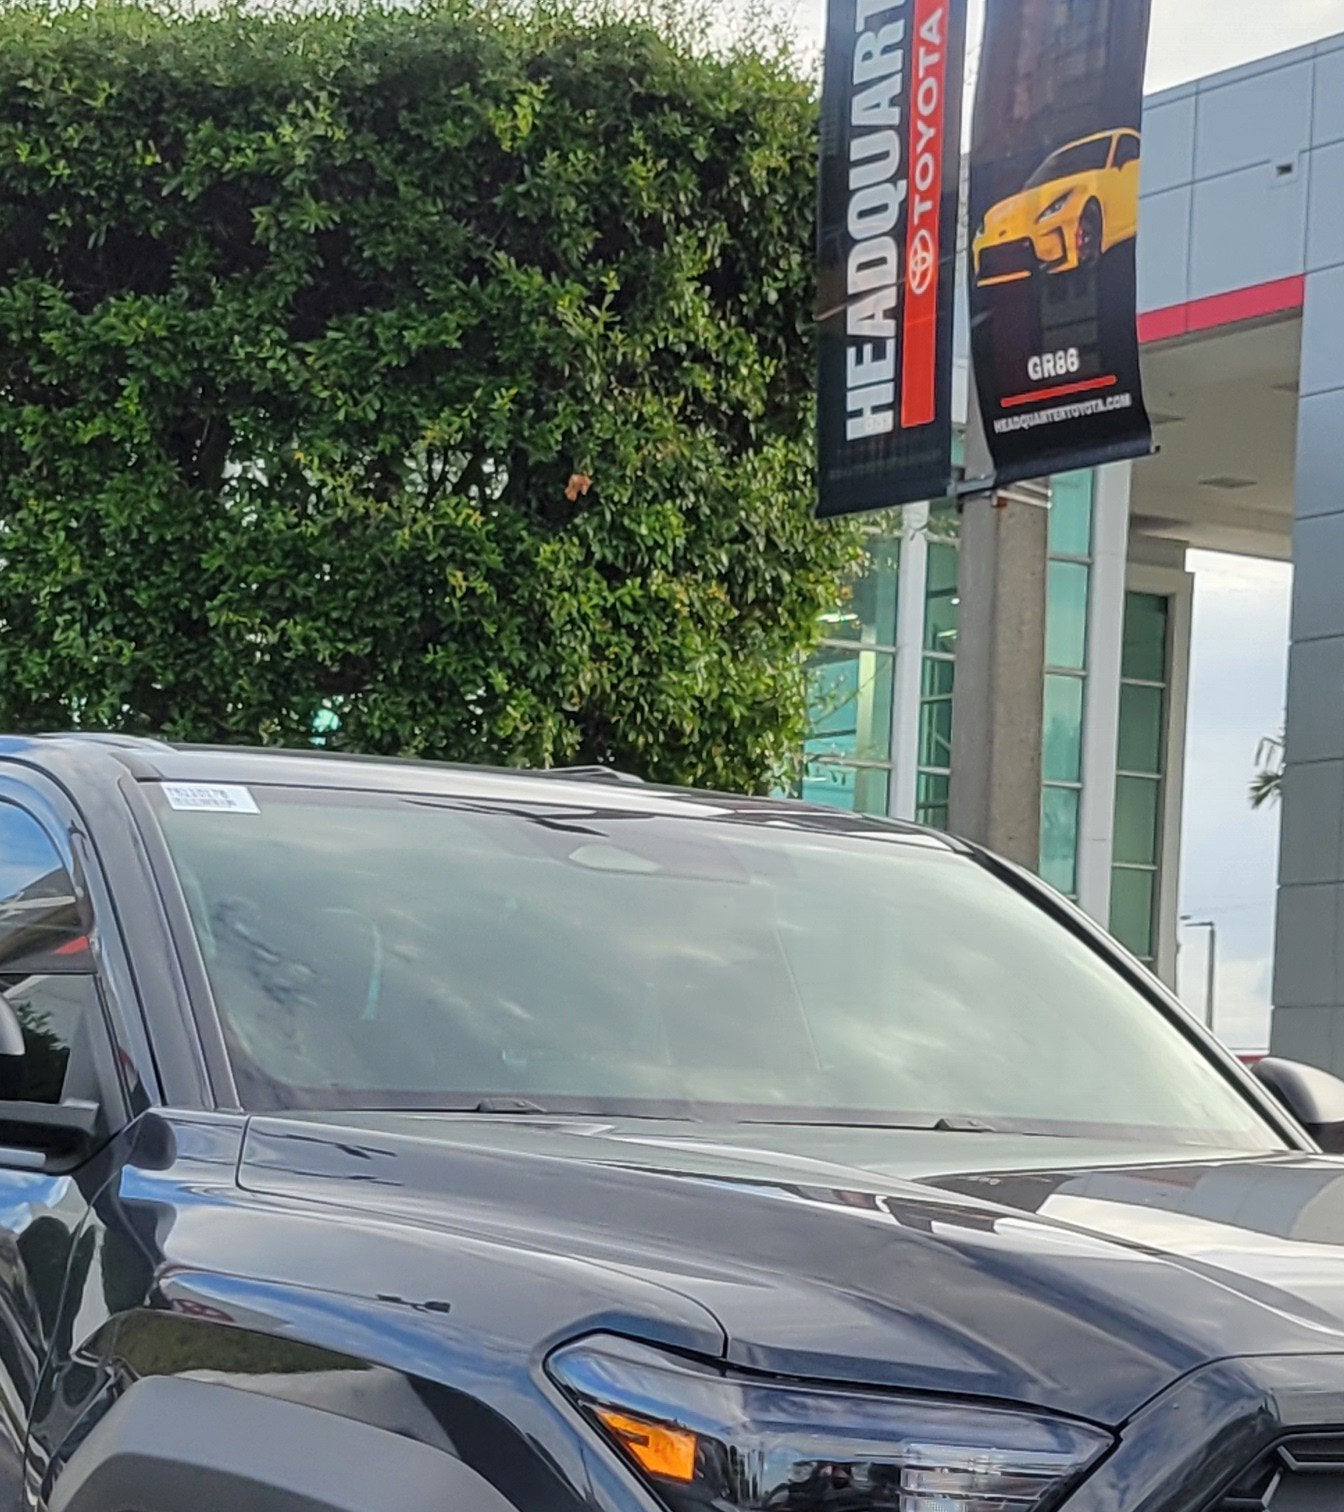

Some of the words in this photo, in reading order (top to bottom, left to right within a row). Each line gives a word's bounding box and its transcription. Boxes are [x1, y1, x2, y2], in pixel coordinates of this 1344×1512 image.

[910, 7, 943, 224] TOYOTA
[1027, 347, 1081, 381] GR86
[993, 392, 1132, 434] HEADQUARTERTOYOTA.COM
